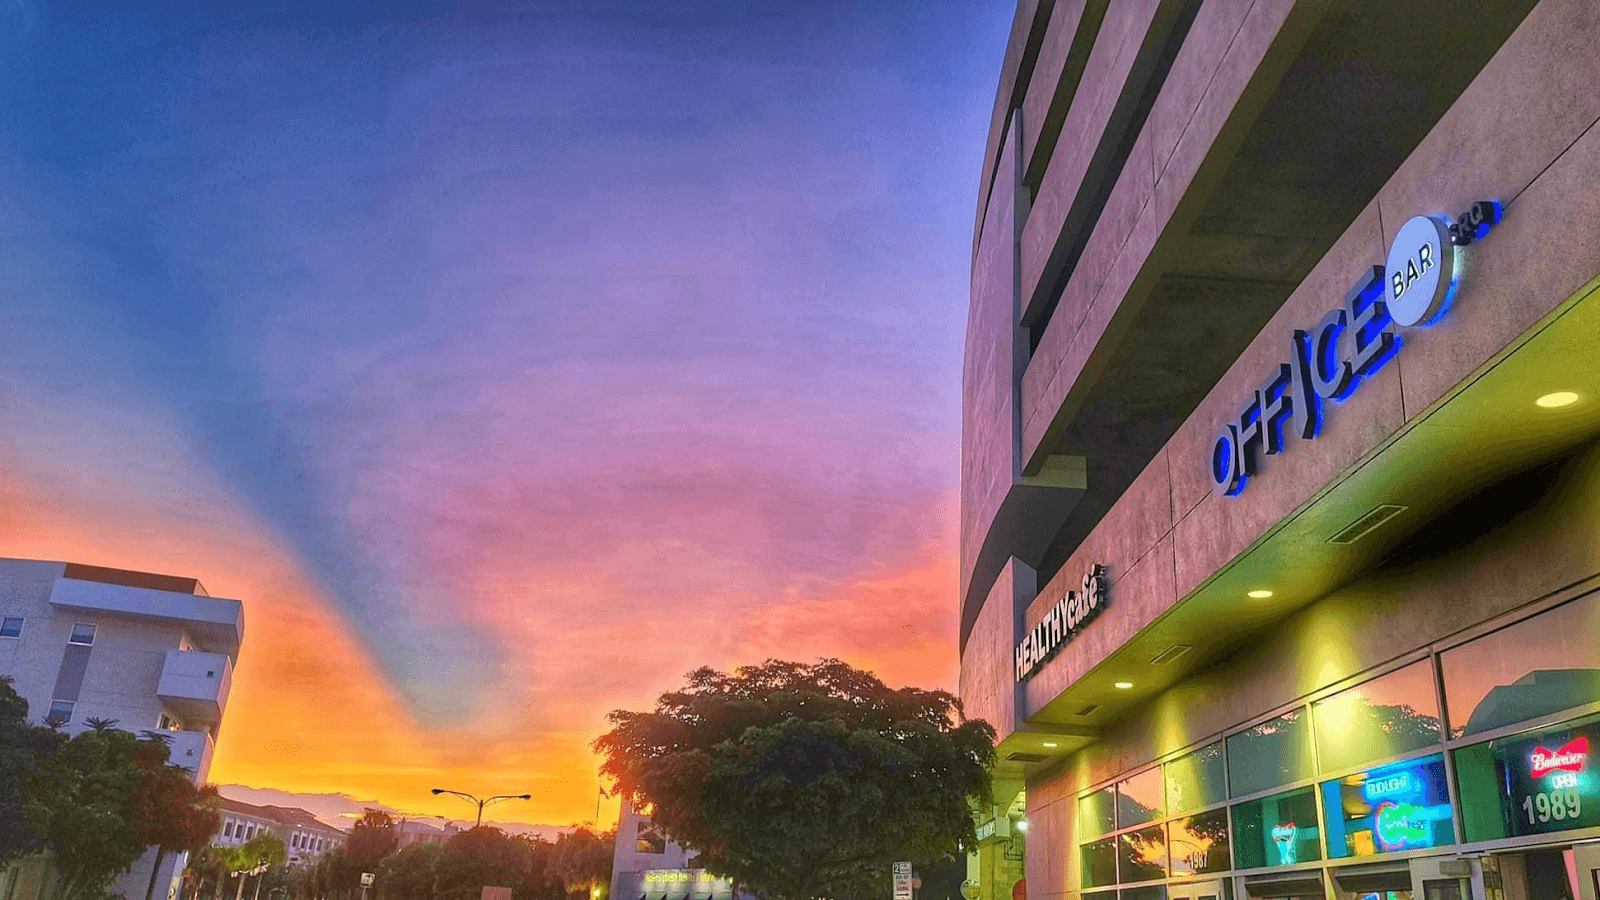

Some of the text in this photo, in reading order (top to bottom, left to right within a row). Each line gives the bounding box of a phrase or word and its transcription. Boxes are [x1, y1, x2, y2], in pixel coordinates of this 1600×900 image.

[1211, 265, 1394, 496] OFFICE
[1391, 243, 1435, 300] BAR
[1531, 750, 1583, 771] Budweiser
[1551, 772, 1578, 789] OPEN
[1523, 788, 1581, 825] 1989
[894, 863, 900, 873] 2
[1189, 850, 1207, 869] 1987
